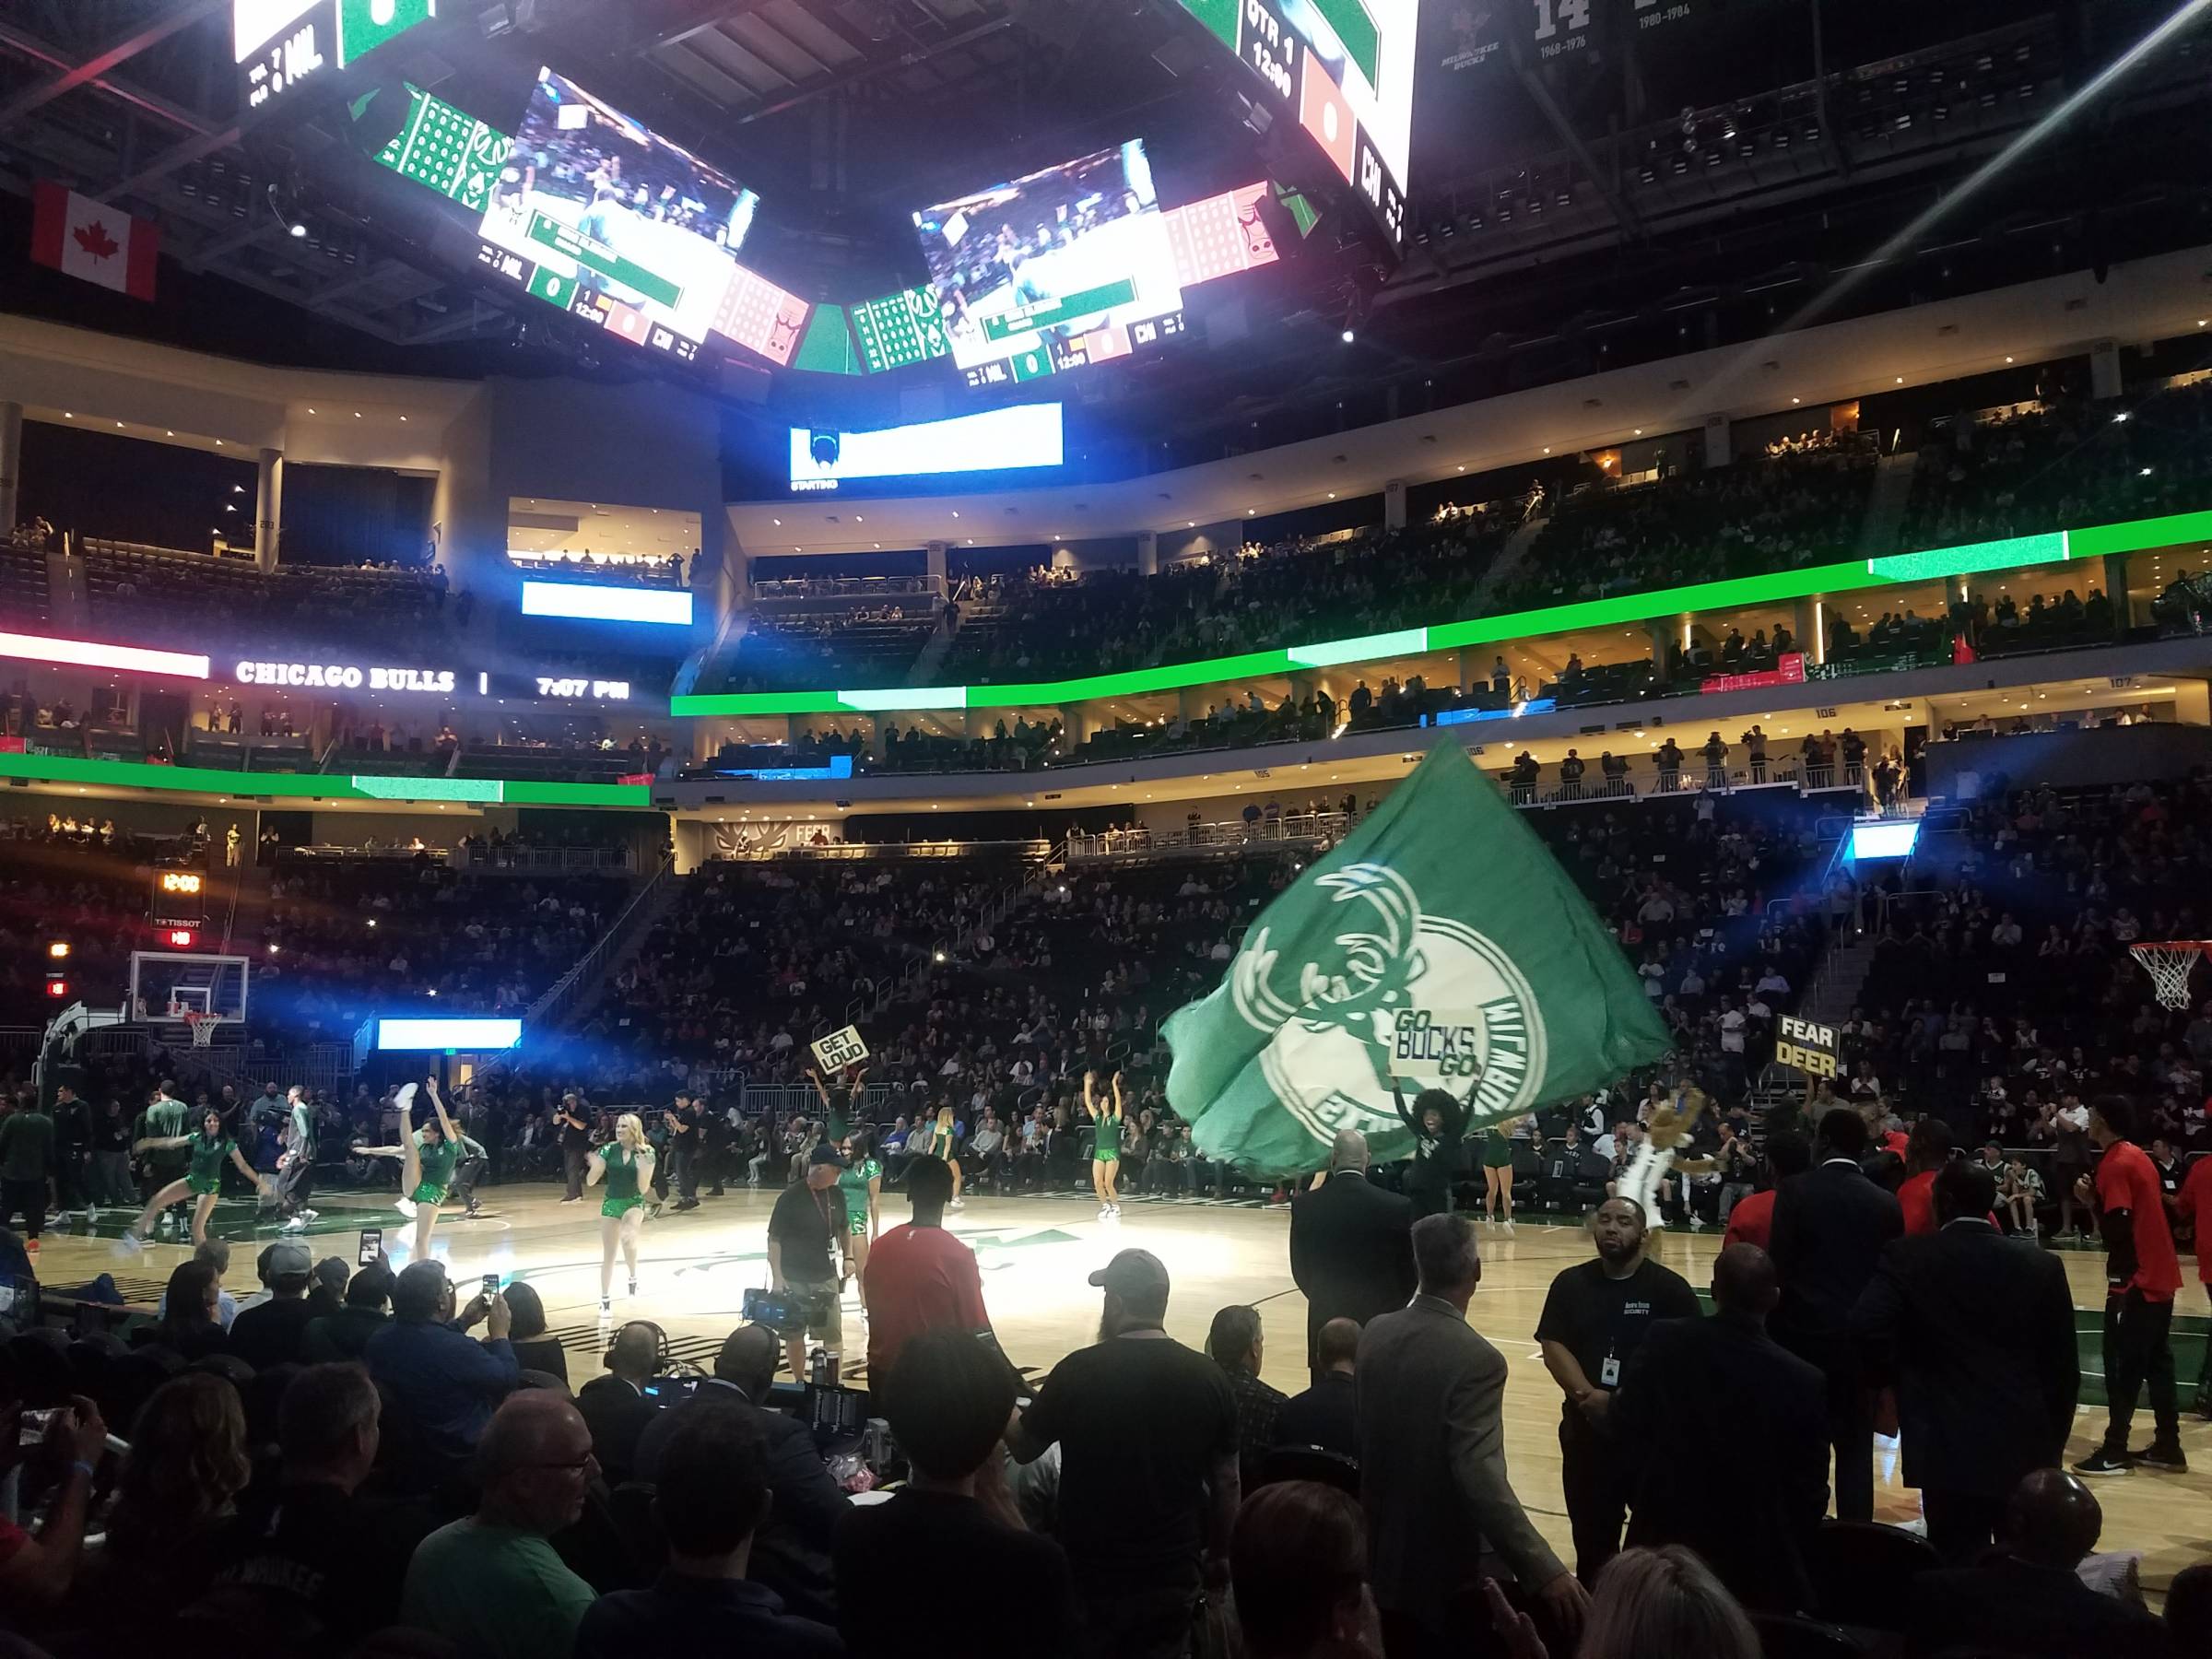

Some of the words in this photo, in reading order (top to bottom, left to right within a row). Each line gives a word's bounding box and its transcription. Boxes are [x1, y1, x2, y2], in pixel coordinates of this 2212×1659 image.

[1247, 0, 1279, 48] QTR
[1283, 36, 1294, 65] 1
[1253, 41, 1292, 98] 12:00
[1361, 145, 1382, 207] CHI
[546, 276, 561, 297] 0
[1025, 353, 1039, 373] 0
[236, 661, 363, 688] CHICAGO
[369, 667, 454, 691] BULLS
[535, 677, 589, 697] 7:07
[593, 680, 629, 700] PM
[2110, 677, 2131, 688] 107
[1816, 708, 1837, 719] 106
[168, 920, 201, 928] TISSOT
[1395, 1010, 1432, 1031] GO
[1782, 1017, 1833, 1048] FEAR
[819, 1030, 851, 1055] GET
[1396, 1026, 1477, 1060] BUCKS
[821, 1042, 865, 1071] LOUD
[1439, 1054, 1478, 1077] GO
[1776, 1041, 1837, 1079] DEER
